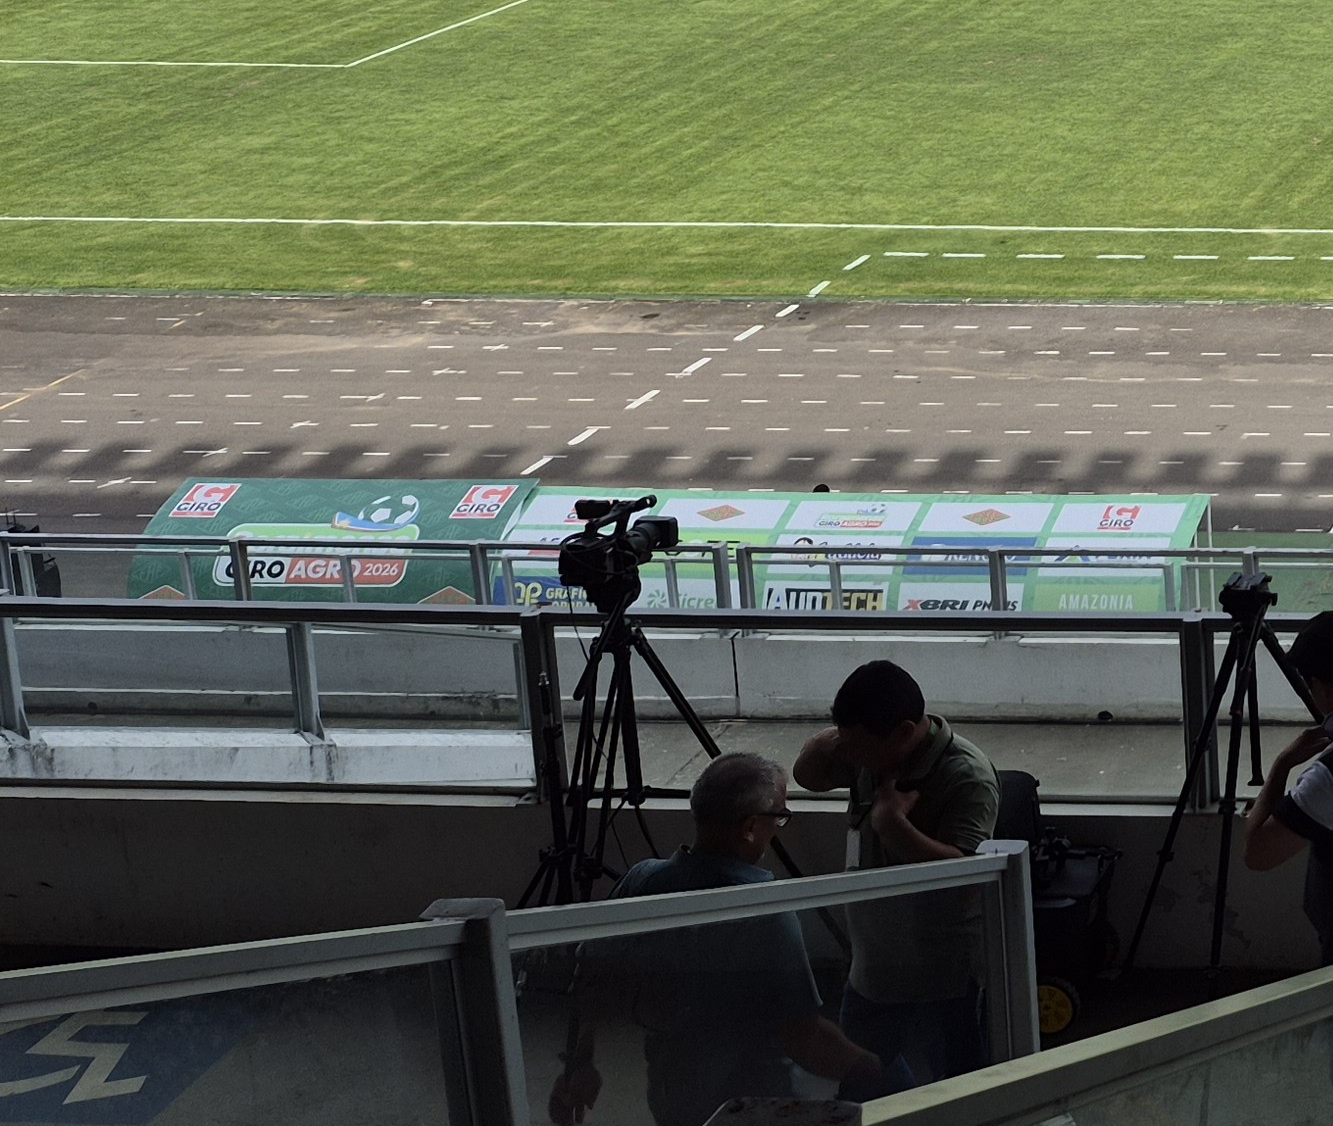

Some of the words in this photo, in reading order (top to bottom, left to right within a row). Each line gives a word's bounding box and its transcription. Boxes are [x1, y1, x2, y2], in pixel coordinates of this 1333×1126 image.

[176, 502, 222, 512] GIRO
[456, 503, 501, 513] GIRO
[1099, 519, 1134, 527] GIRO
[365, 563, 399, 576] 2026
[1058, 594, 1134, 610] AMAZONIA
